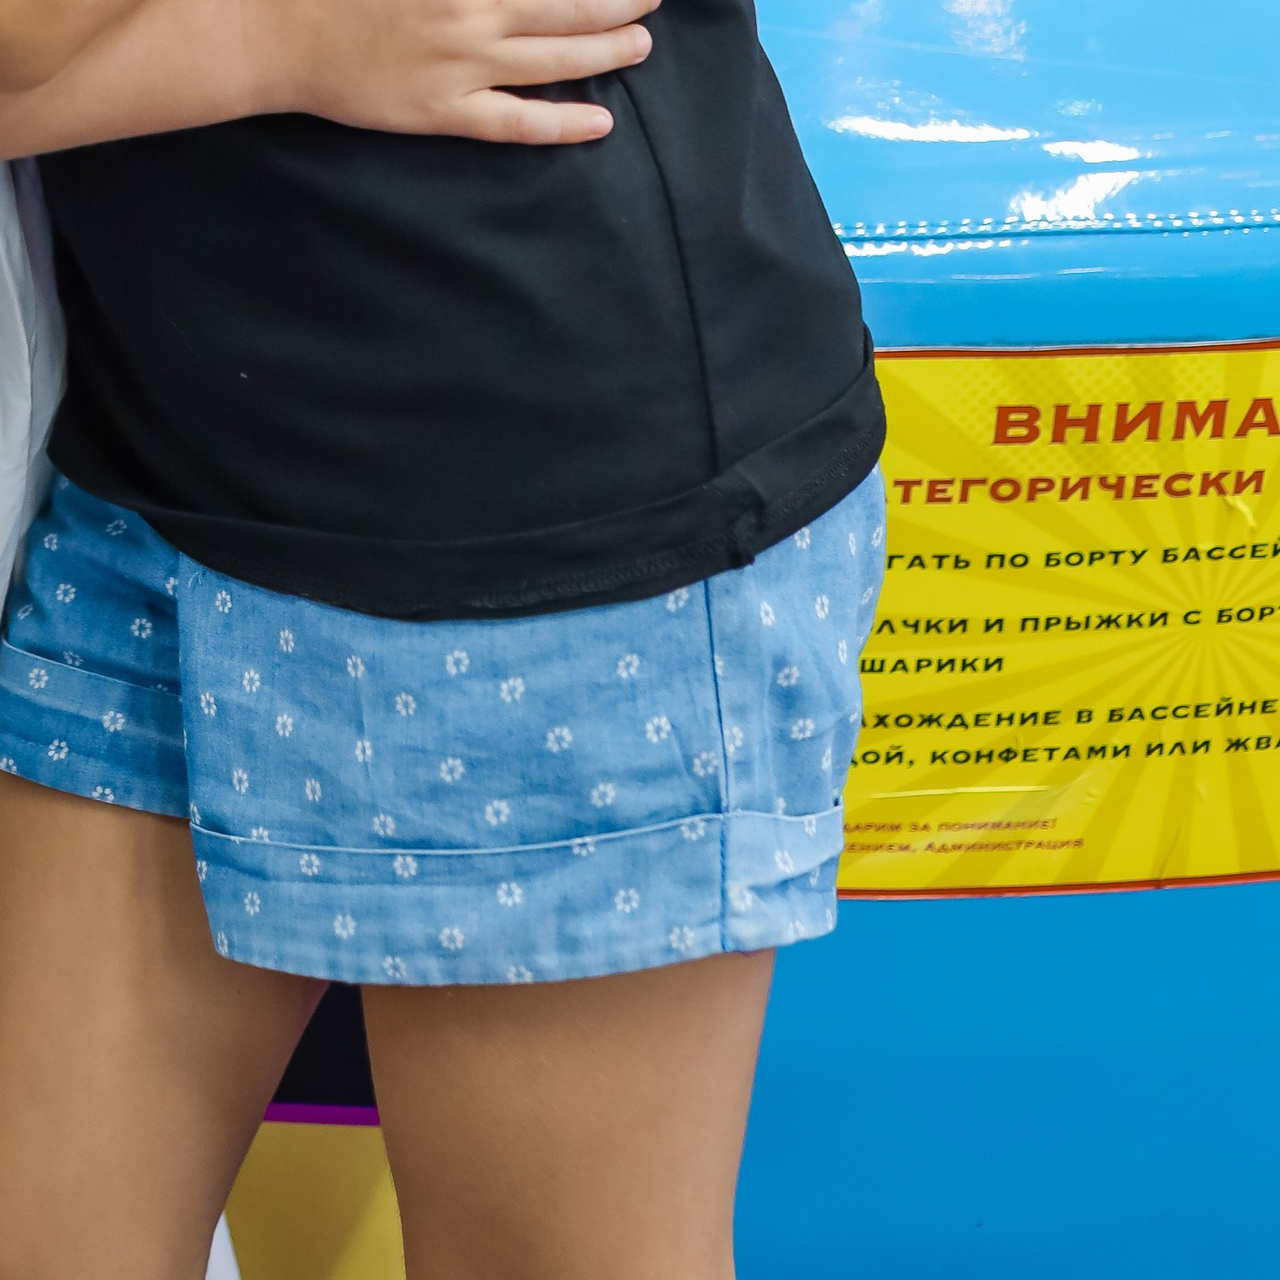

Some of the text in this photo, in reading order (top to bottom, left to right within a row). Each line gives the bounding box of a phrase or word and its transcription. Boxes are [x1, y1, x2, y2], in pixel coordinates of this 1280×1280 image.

[991, 397, 1280, 446] ВНИМА
[886, 470, 1266, 505] ТЕГОРИЧЕСКИ
[986, 552, 1029, 570] ПО
[1045, 549, 1149, 568] БОРТУ
[871, 606, 1280, 635] ЛЧКИ И ПРЫЖКИ С БОР
[860, 657, 1004, 674] ШАРИКИ
[1076, 708, 1094, 725] В
[1108, 697, 1278, 724] БАССЕЙНЕ
[930, 744, 1131, 765] КОНФЕТАМИ
[1145, 740, 1211, 758] ИЛИ
[908, 822, 931, 834] ЗА
